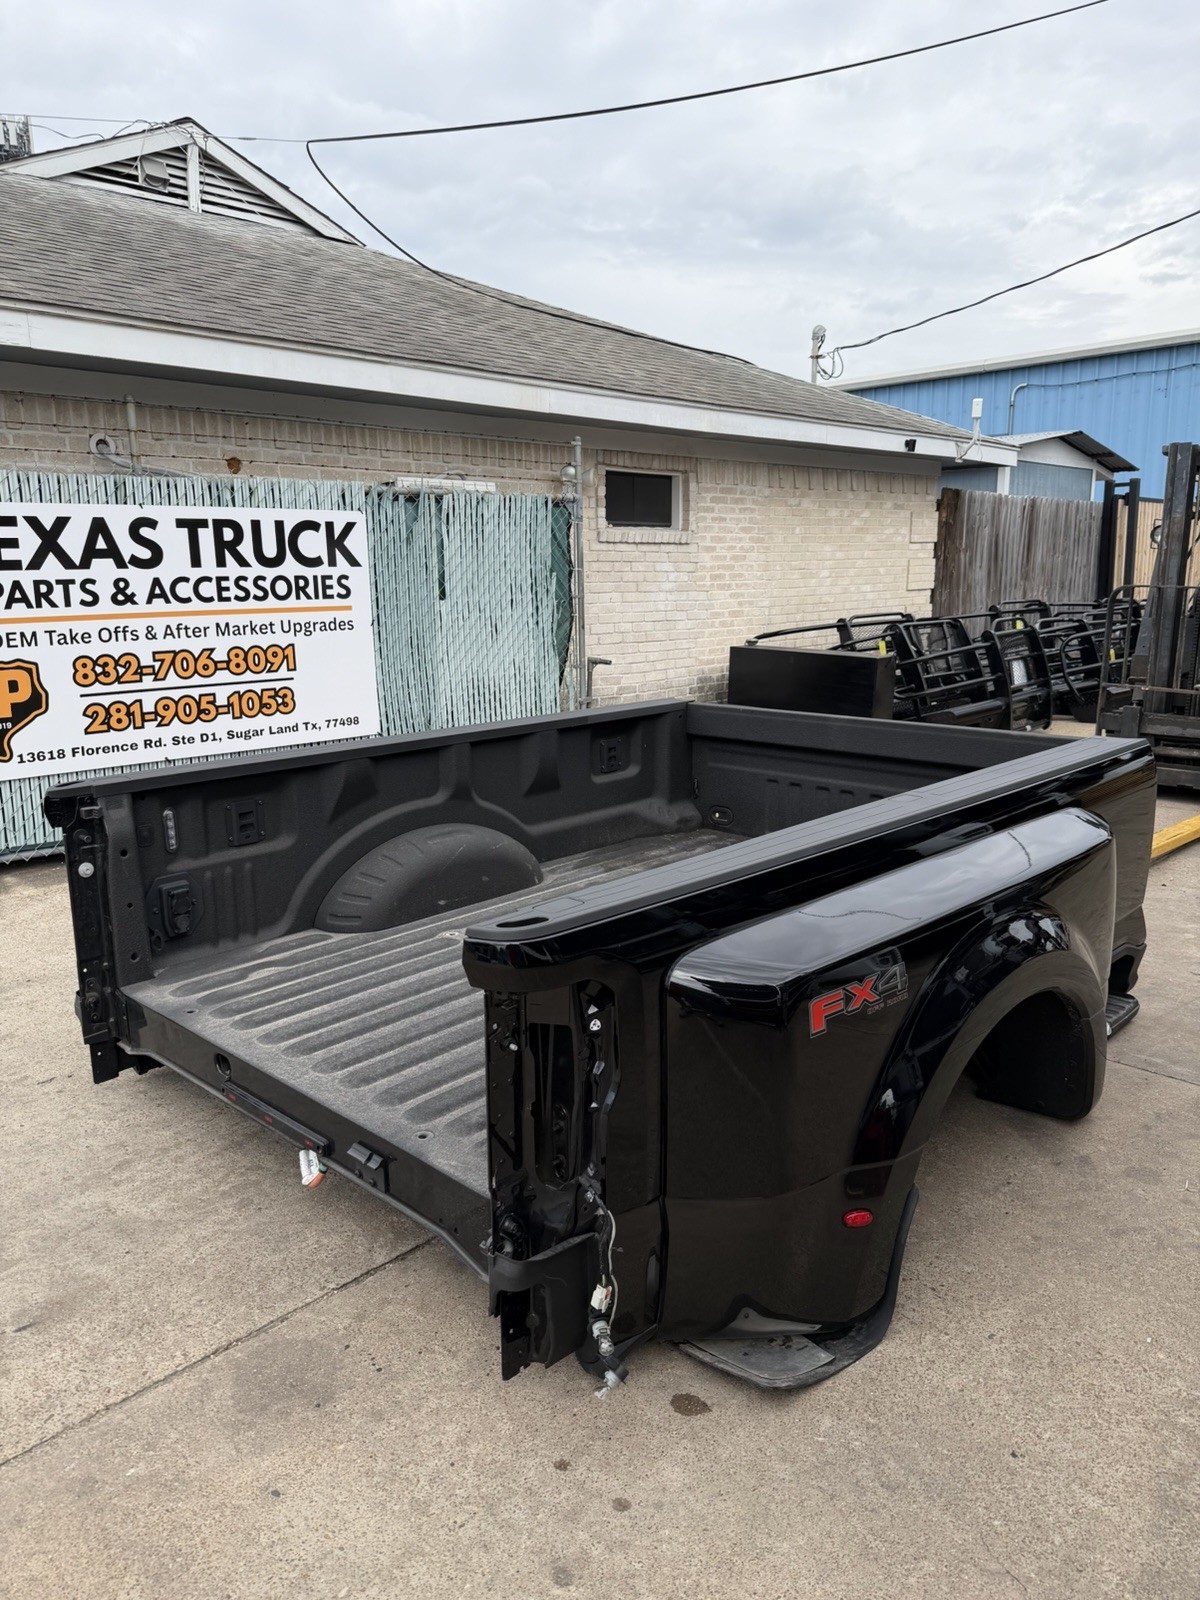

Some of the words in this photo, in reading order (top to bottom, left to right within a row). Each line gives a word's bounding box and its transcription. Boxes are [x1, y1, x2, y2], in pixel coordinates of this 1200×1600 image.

[175, 517, 363, 569] TRUCK
[0, 577, 100, 610] ARTS
[110, 576, 140, 607] &
[145, 574, 352, 606] ACCESSORIES
[0, 630, 38, 649] EM
[44, 628, 92, 646] Take
[98, 626, 140, 644] Offs
[145, 625, 158, 641] &
[163, 623, 210, 640] After
[215, 620, 276, 637] Market
[280, 617, 355, 637] Upgrades
[72, 643, 297, 687] 832-706-8091
[82, 686, 296, 735] 281-905-1053
[17, 749, 66, 764] 13618
[71, 740, 139, 758] Florence
[143, 738, 167, 750] Rd.
[171, 734, 196, 747] Ste
[200, 732, 222, 744] D1,
[226, 728, 265, 741] Sugar
[268, 723, 299, 736] Land
[302, 721, 322, 732] Tx,
[325, 716, 360, 729] 77498
[808, 961, 909, 1038] FX4
